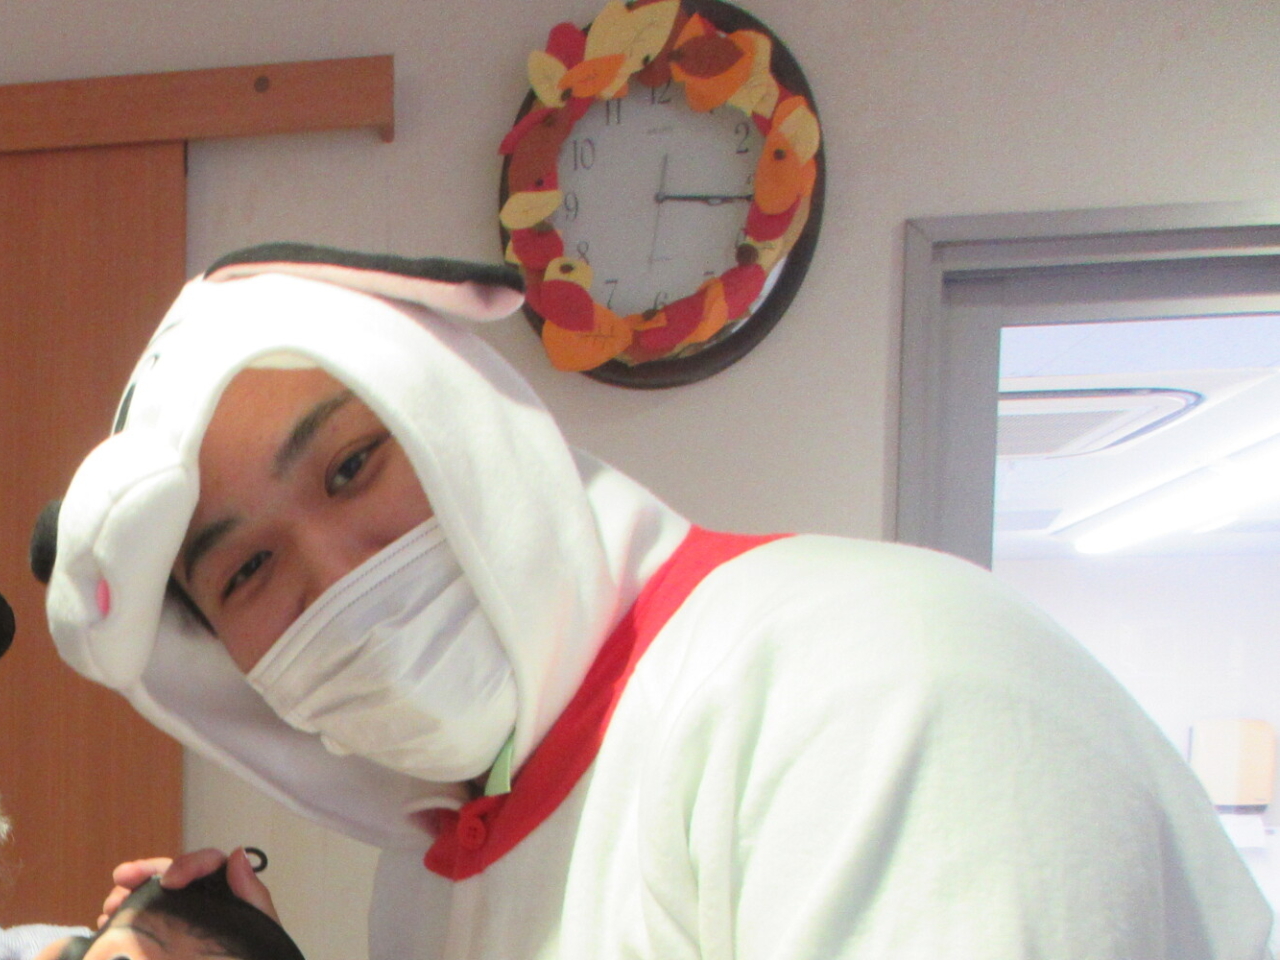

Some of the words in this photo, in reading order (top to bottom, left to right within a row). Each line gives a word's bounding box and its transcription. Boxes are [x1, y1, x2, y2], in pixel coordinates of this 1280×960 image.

[734, 122, 750, 154] 2
[571, 138, 596, 172] 10
[564, 191, 579, 222] 9
[604, 279, 618, 310] 7
